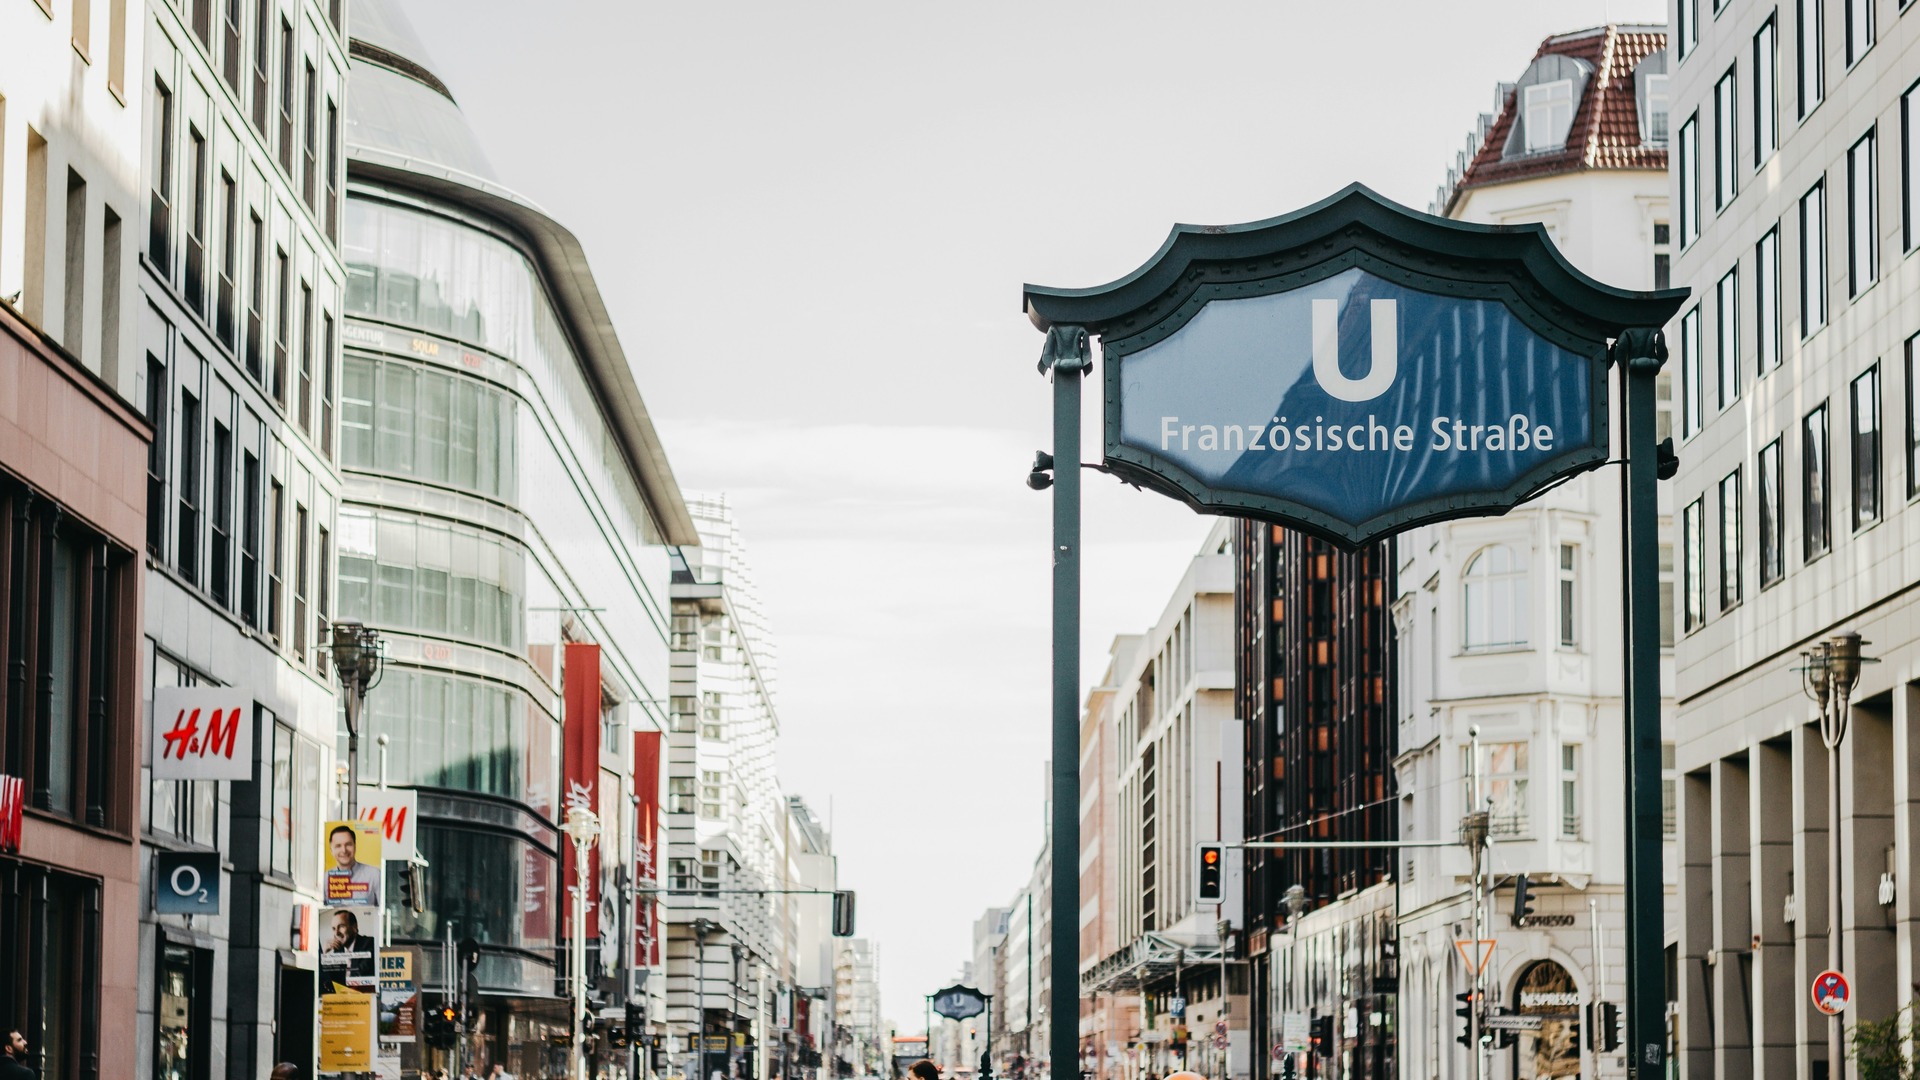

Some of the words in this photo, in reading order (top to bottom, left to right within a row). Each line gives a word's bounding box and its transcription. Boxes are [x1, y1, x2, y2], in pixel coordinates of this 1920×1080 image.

[412, 338, 440, 356] SOLAR
[1312, 298, 1398, 403] U
[1160, 414, 1414, 452] Französische
[1431, 413, 1554, 452] Straße
[162, 706, 241, 760] H&M
[1511, 914, 1575, 927] NSPRESSO
